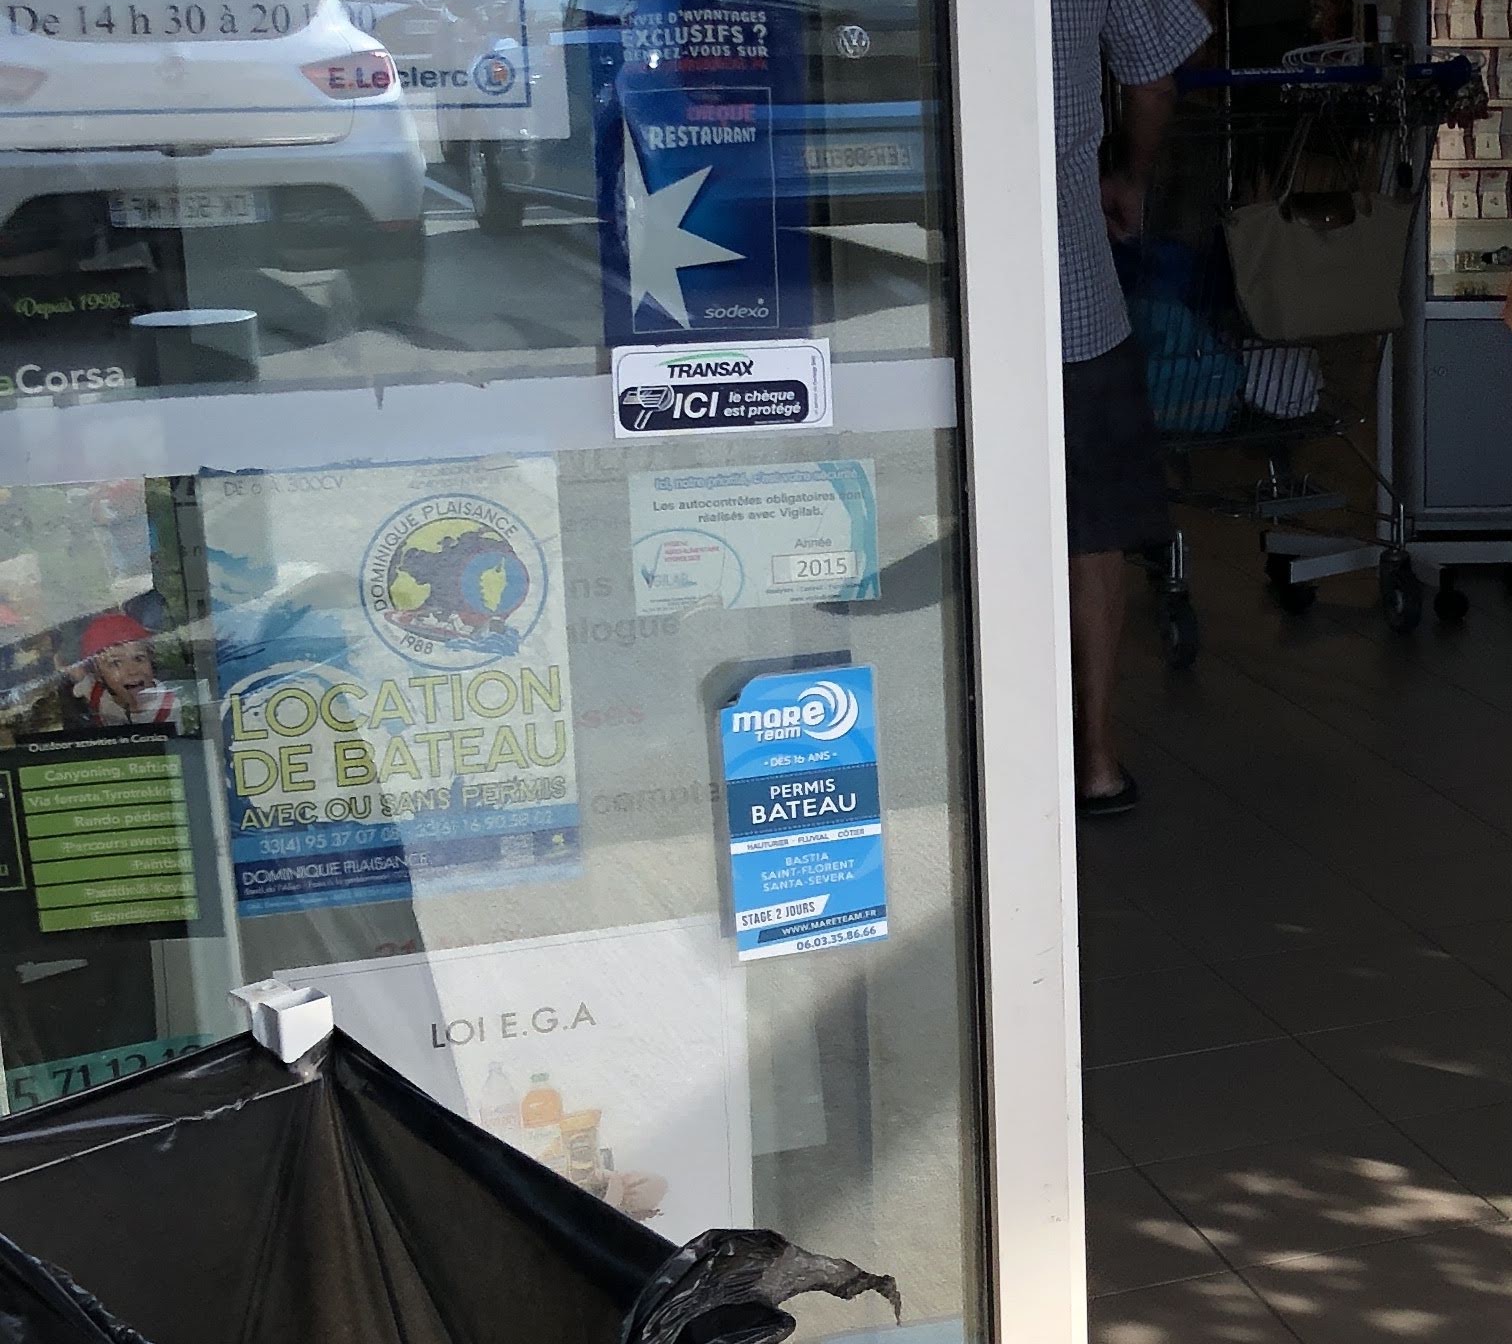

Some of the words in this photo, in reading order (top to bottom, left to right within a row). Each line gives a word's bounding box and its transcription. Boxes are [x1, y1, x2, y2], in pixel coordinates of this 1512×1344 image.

[7, 4, 61, 39] De
[77, 3, 115, 37] 14
[127, 2, 152, 36] h
[164, 2, 206, 35] 30
[218, 1, 239, 34] à
[249, 1, 291, 35] 20
[621, 24, 744, 47] EXCLUSIFS
[737, 45, 769, 58] SUR
[328, 67, 470, 90] E.Leclerc
[649, 123, 757, 150] RESTAURANT
[703, 297, 769, 320] sodexo
[667, 360, 755, 379] TRANSAX
[673, 391, 720, 419] ICI
[729, 392, 743, 404] le
[745, 389, 796, 407] chèque
[723, 406, 746, 418] est
[749, 401, 801, 419] protégé
[653, 499, 676, 512] Les
[678, 494, 763, 511] autocontrôles
[765, 491, 836, 507] obligatoires
[748, 508, 778, 520] avec
[794, 537, 834, 550] Année
[370, 514, 420, 612] DOMINIQUE
[422, 501, 520, 539] PLAISANCE
[797, 557, 848, 578] 2015
[400, 633, 435, 655] 1988
[230, 665, 563, 742] LOCATION
[233, 743, 318, 797] DE
[335, 719, 568, 788] BATEAU
[808, 752, 831, 763] ANS
[130, 761, 179, 777] Rafting
[770, 778, 836, 800] PERMIS
[240, 798, 318, 832] AVEC
[323, 795, 374, 825] OU
[381, 787, 451, 819] SANS
[462, 776, 568, 810] PERMIS
[752, 793, 858, 825] BATEAU
[75, 813, 120, 827] Rando
[305, 833, 329, 850] 95
[331, 830, 353, 848] 37
[797, 833, 830, 845] FLUVIAL
[836, 827, 866, 839] CÔTIER
[243, 862, 343, 887] DOMINIQUE
[344, 853, 433, 875] PLAISANCE
[761, 859, 856, 881] SAINT-FLORENT
[785, 852, 830, 867] BASTIA
[762, 872, 856, 893] SANTA-SEVERA
[741, 911, 773, 927] STAGE
[776, 908, 783, 921] 2
[785, 901, 816, 919] JOURS
[781, 909, 877, 936] WWW.MARETEAM.FR
[796, 925, 877, 951] 06.03.35.86.66
[430, 1016, 486, 1049] LOI
[502, 1001, 597, 1041] E.G.A
[53, 1063, 92, 1096] 71
